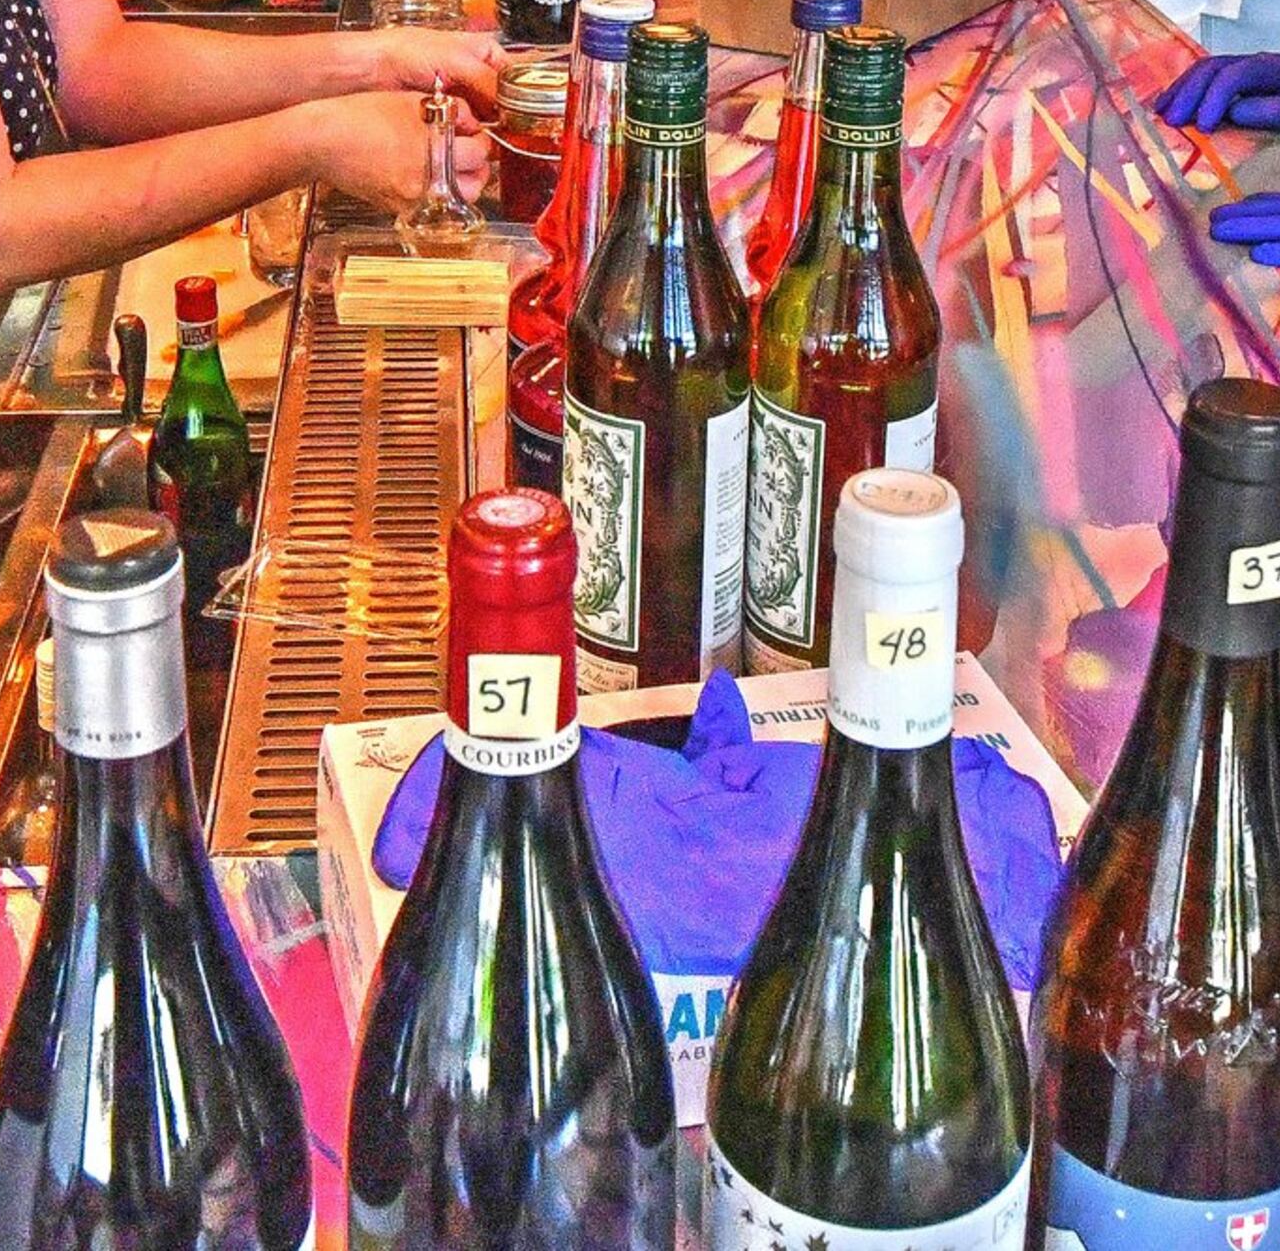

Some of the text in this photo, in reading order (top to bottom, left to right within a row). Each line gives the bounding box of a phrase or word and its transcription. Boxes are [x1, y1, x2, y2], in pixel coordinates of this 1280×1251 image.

[659, 125, 705, 141] DOLIN
[838, 128, 891, 143] DOLIN
[878, 626, 927, 666] 48
[478, 677, 533, 717] 57
